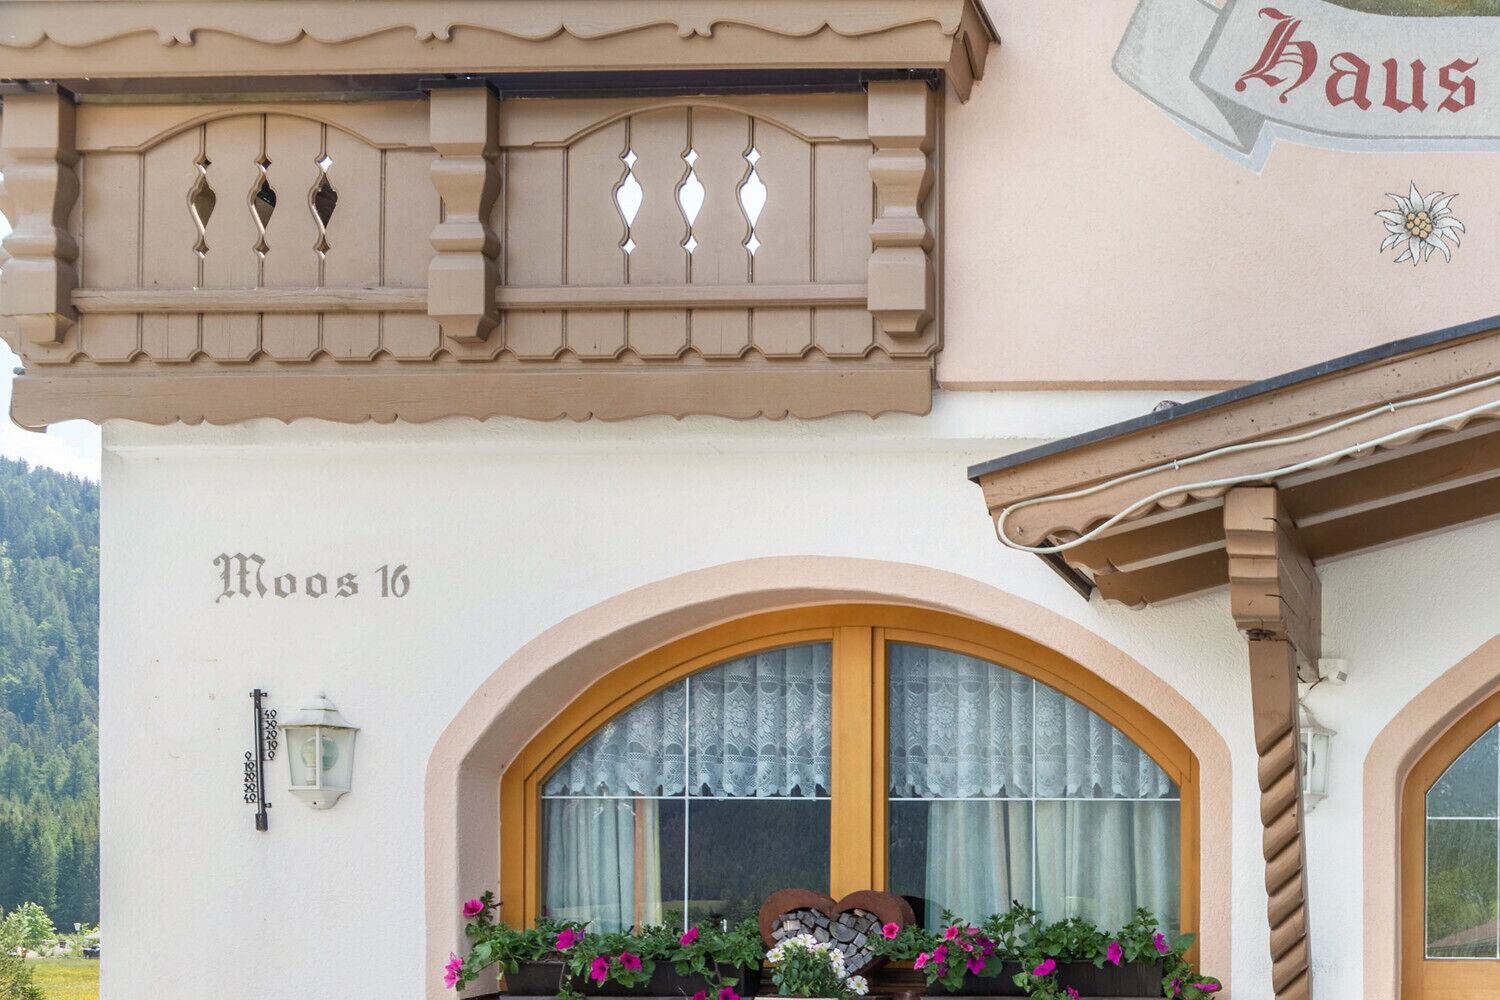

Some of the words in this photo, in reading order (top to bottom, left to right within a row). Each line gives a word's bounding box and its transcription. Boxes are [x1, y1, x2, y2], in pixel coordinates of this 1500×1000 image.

[1234, 7, 1480, 114] Haus
[212, 551, 360, 604] Moos
[374, 563, 411, 598] 16
[266, 730, 278, 739] 20
[267, 740, 278, 750] 10
[244, 761, 255, 771] 10
